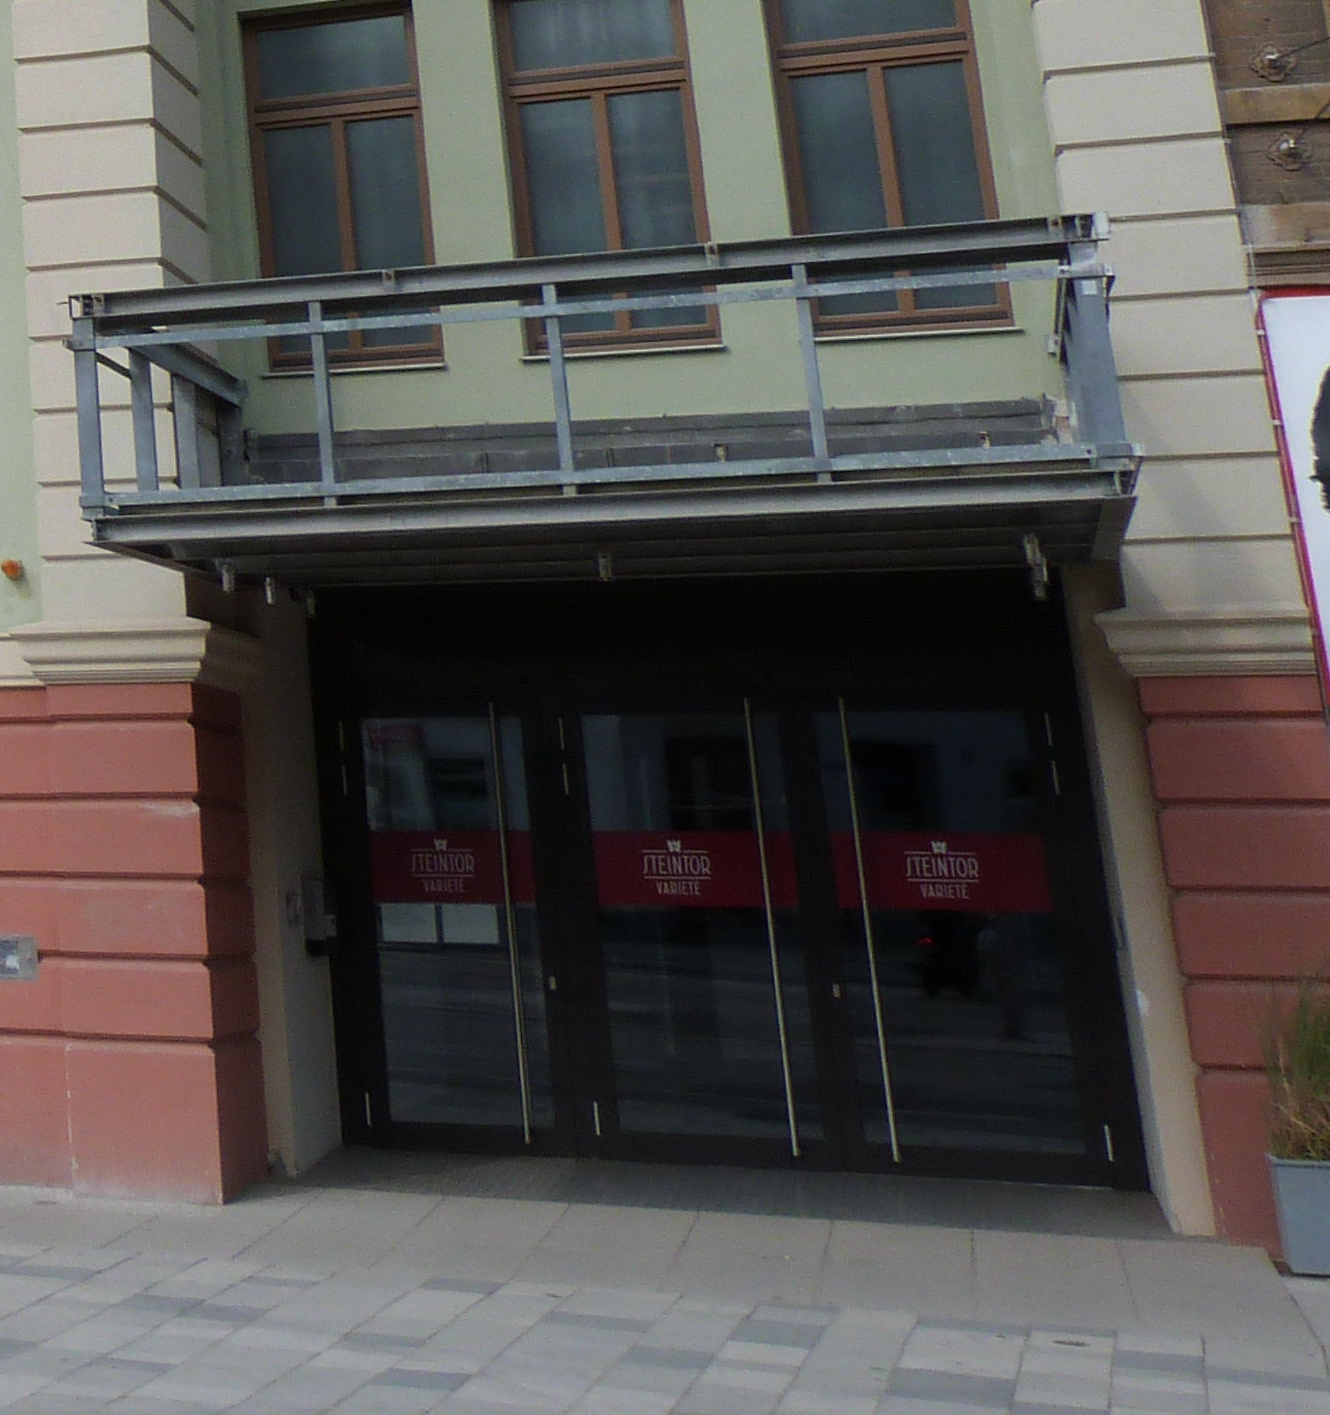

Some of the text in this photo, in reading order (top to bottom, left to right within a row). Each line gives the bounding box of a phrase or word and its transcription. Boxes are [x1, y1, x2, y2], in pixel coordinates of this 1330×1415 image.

[411, 853, 476, 874] STEINTOR
[642, 855, 712, 876] STEINTOR
[905, 856, 980, 878] STEINTOR
